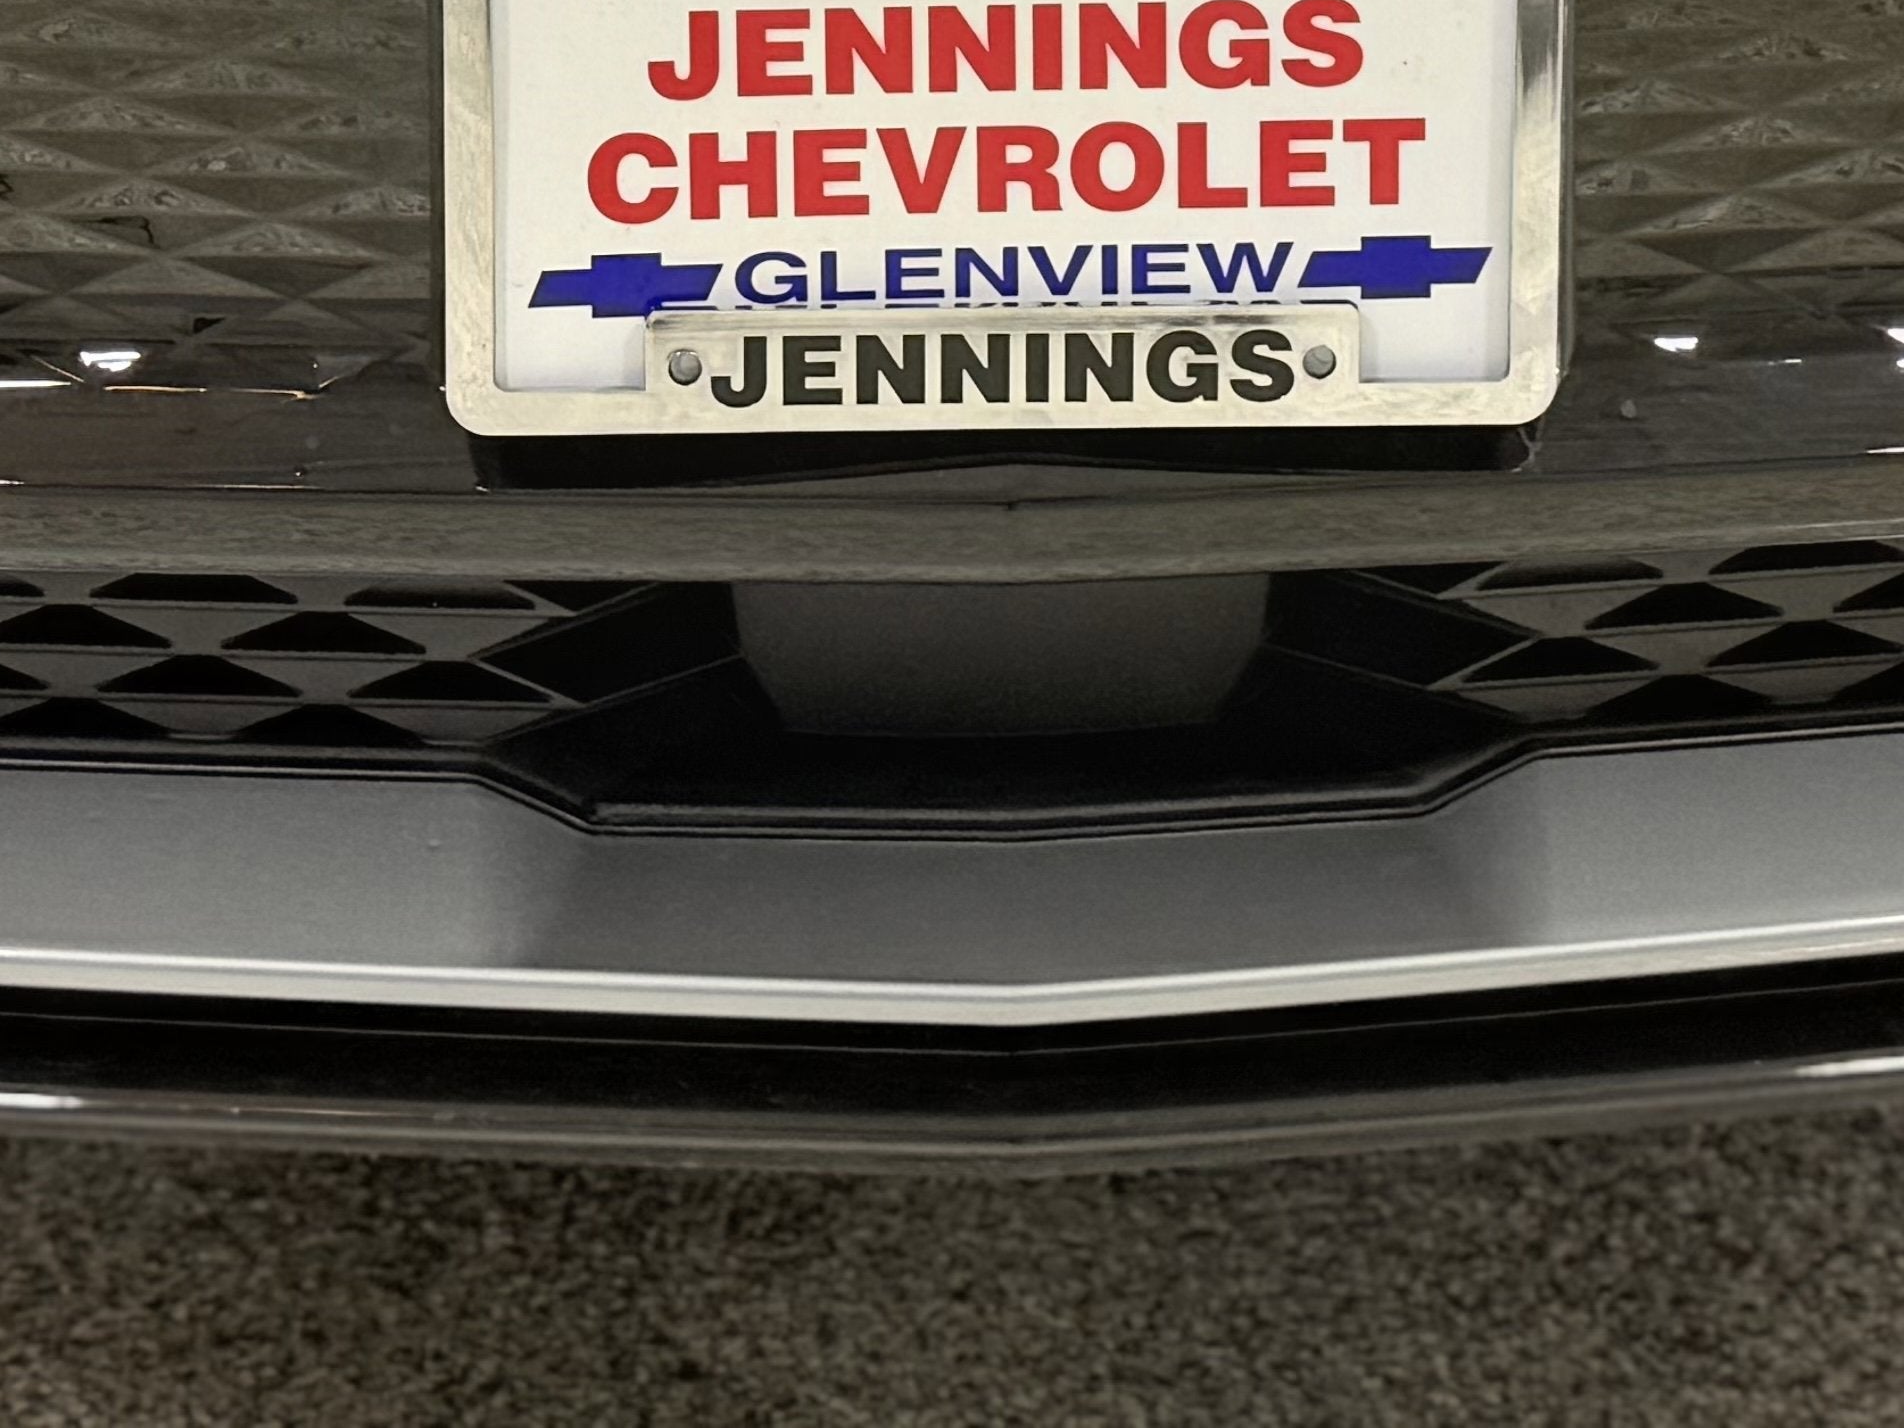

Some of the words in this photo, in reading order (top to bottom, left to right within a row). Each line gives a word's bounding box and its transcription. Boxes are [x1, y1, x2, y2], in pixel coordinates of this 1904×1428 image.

[586, 117, 1427, 226] CHEVROLET
[733, 242, 1295, 305] GLENVIEW
[709, 328, 1296, 409] JENNINGS
